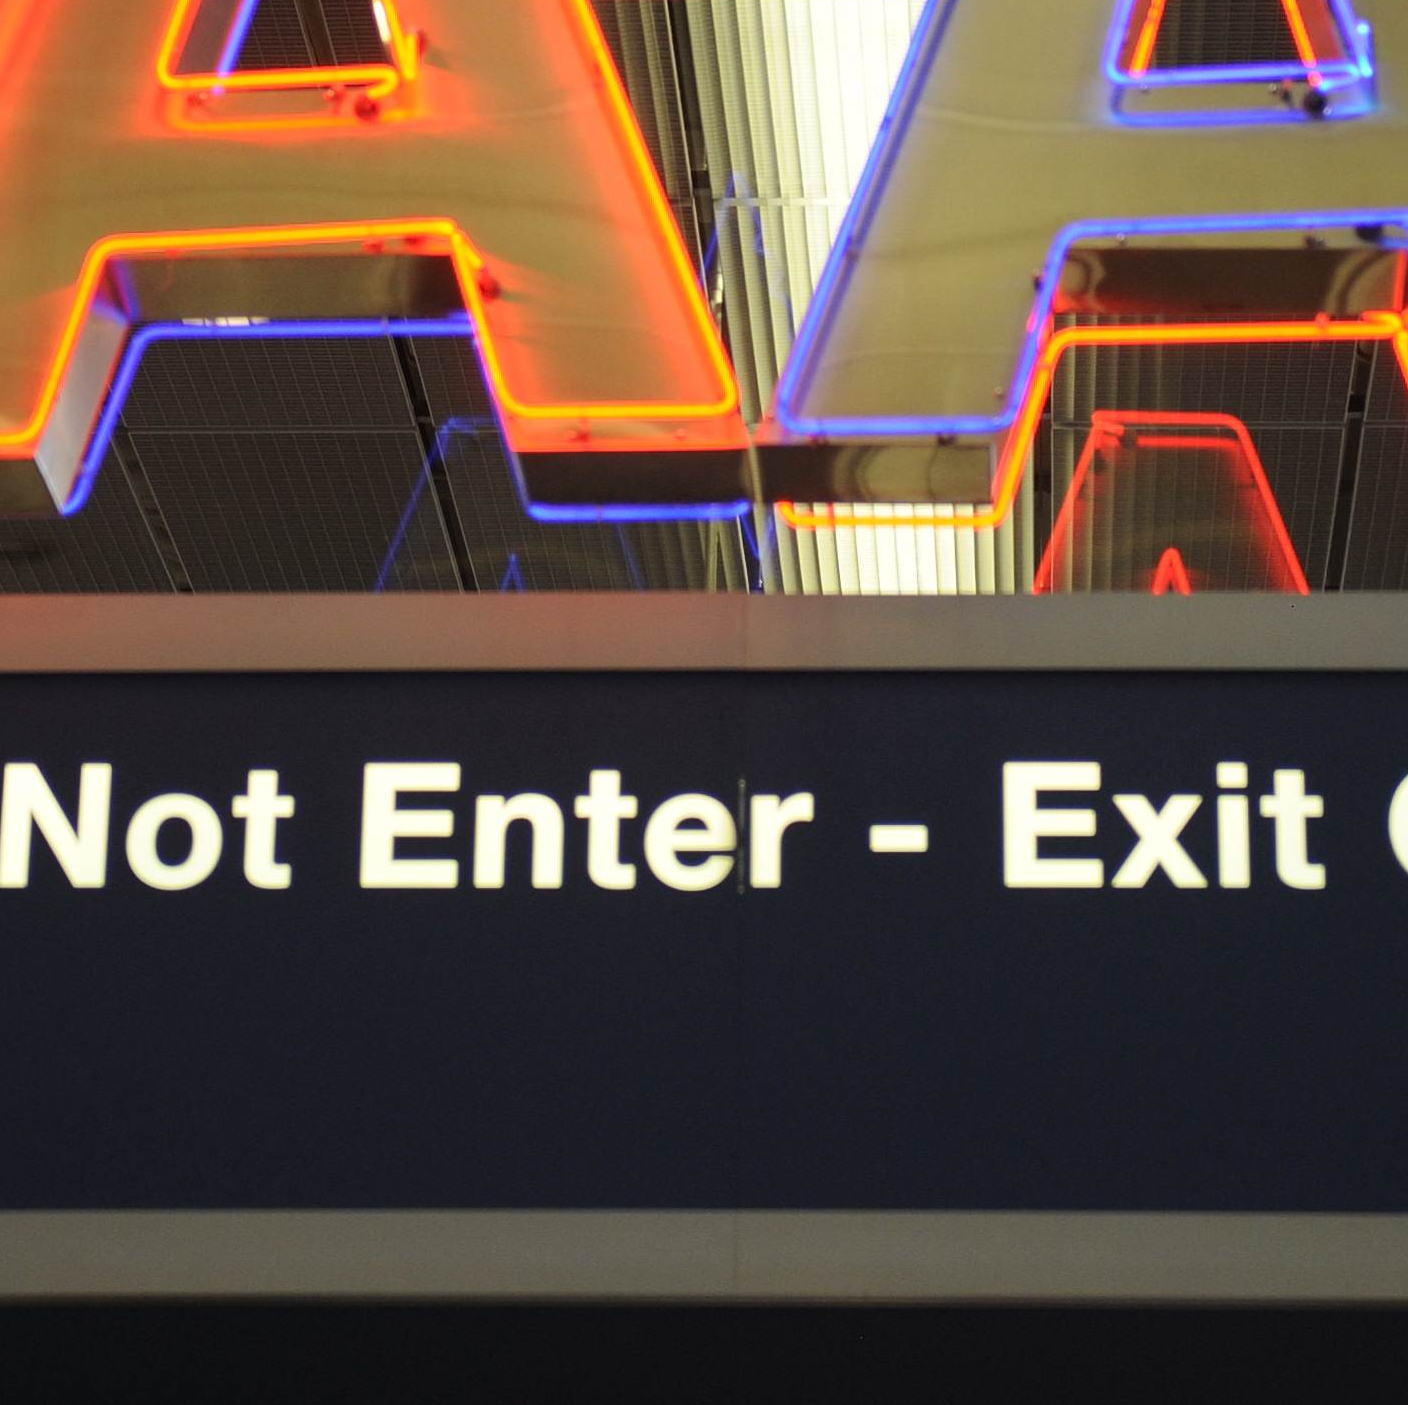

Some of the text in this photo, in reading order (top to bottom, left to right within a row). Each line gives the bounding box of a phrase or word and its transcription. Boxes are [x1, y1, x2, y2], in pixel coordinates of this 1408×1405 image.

[358, 760, 816, 893] Enter
[868, 823, 929, 854] -
[1001, 760, 1327, 890] Exit
